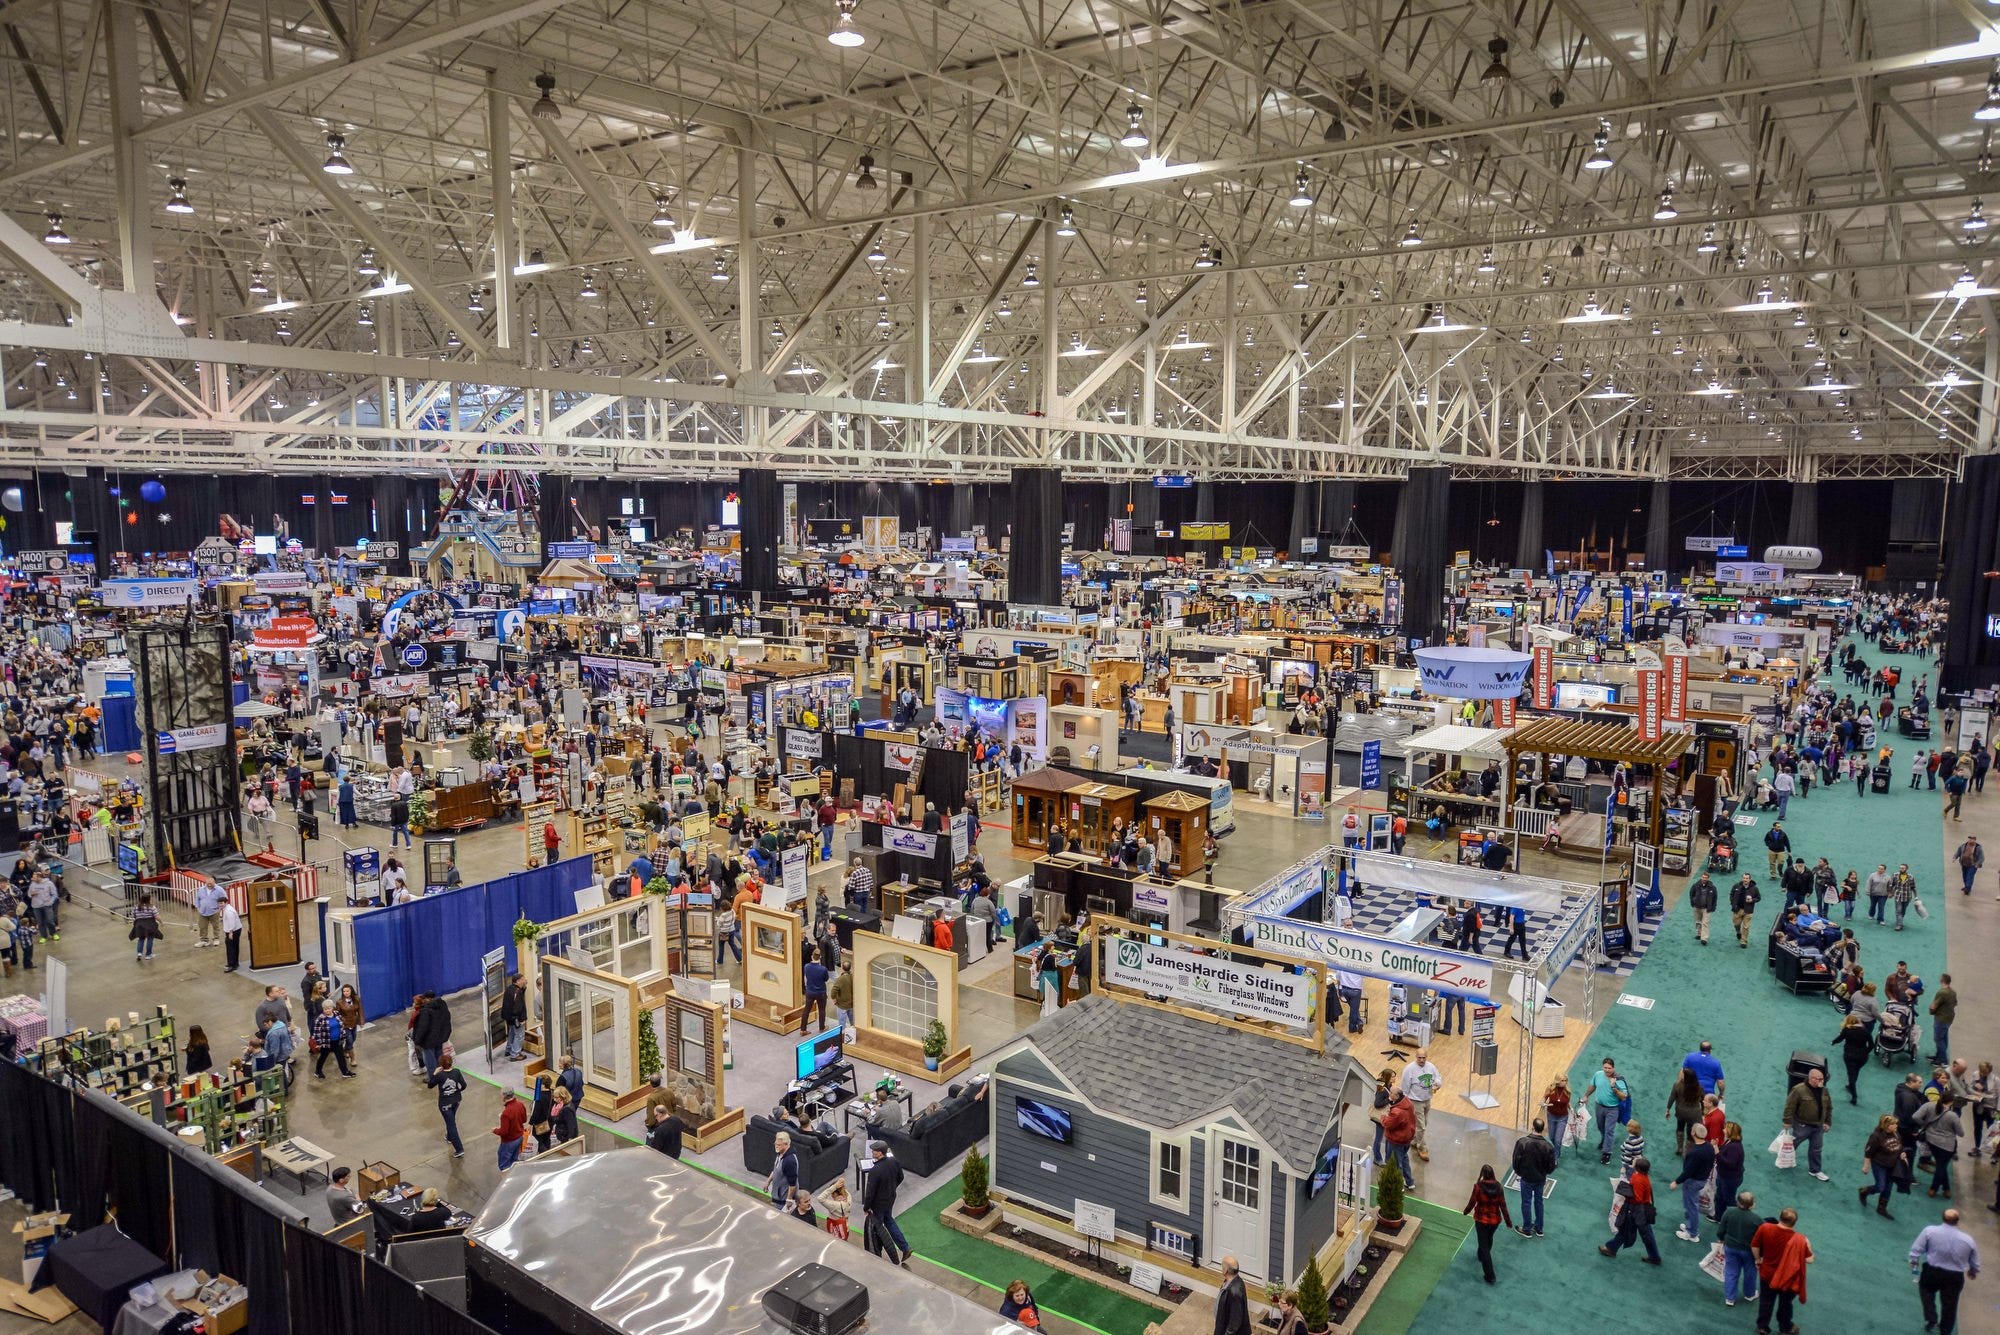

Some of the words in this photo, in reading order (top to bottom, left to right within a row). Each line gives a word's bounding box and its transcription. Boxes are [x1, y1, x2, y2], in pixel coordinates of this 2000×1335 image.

[21, 553, 42, 562] 1400
[199, 549, 217, 557] 1300
[147, 586, 186, 596] DIRECTV
[408, 651, 423, 660] ADT
[1479, 683, 1510, 691] WINDOW
[787, 743, 803, 751] GLASS
[1222, 740, 1297, 755] AdaptMyHouse.com
[611, 782, 625, 790] CSA
[1256, 921, 1307, 948] Blind
[1327, 937, 1374, 964] Sons
[1382, 949, 1438, 977] Comfort
[1431, 962, 1488, 990] Zone
[1146, 952, 1239, 985] JamesHardie
[1245, 974, 1294, 997] Siding
[1114, 971, 1140, 984] Brought
[1142, 977, 1150, 985] to
[1151, 980, 1163, 989] you
[1164, 982, 1174, 992] by
[1218, 982, 1254, 1000] Fiberglass
[1256, 990, 1289, 1009] Windows
[1231, 999, 1261, 1013] Exterior
[1262, 1004, 1306, 1022] Renovators
